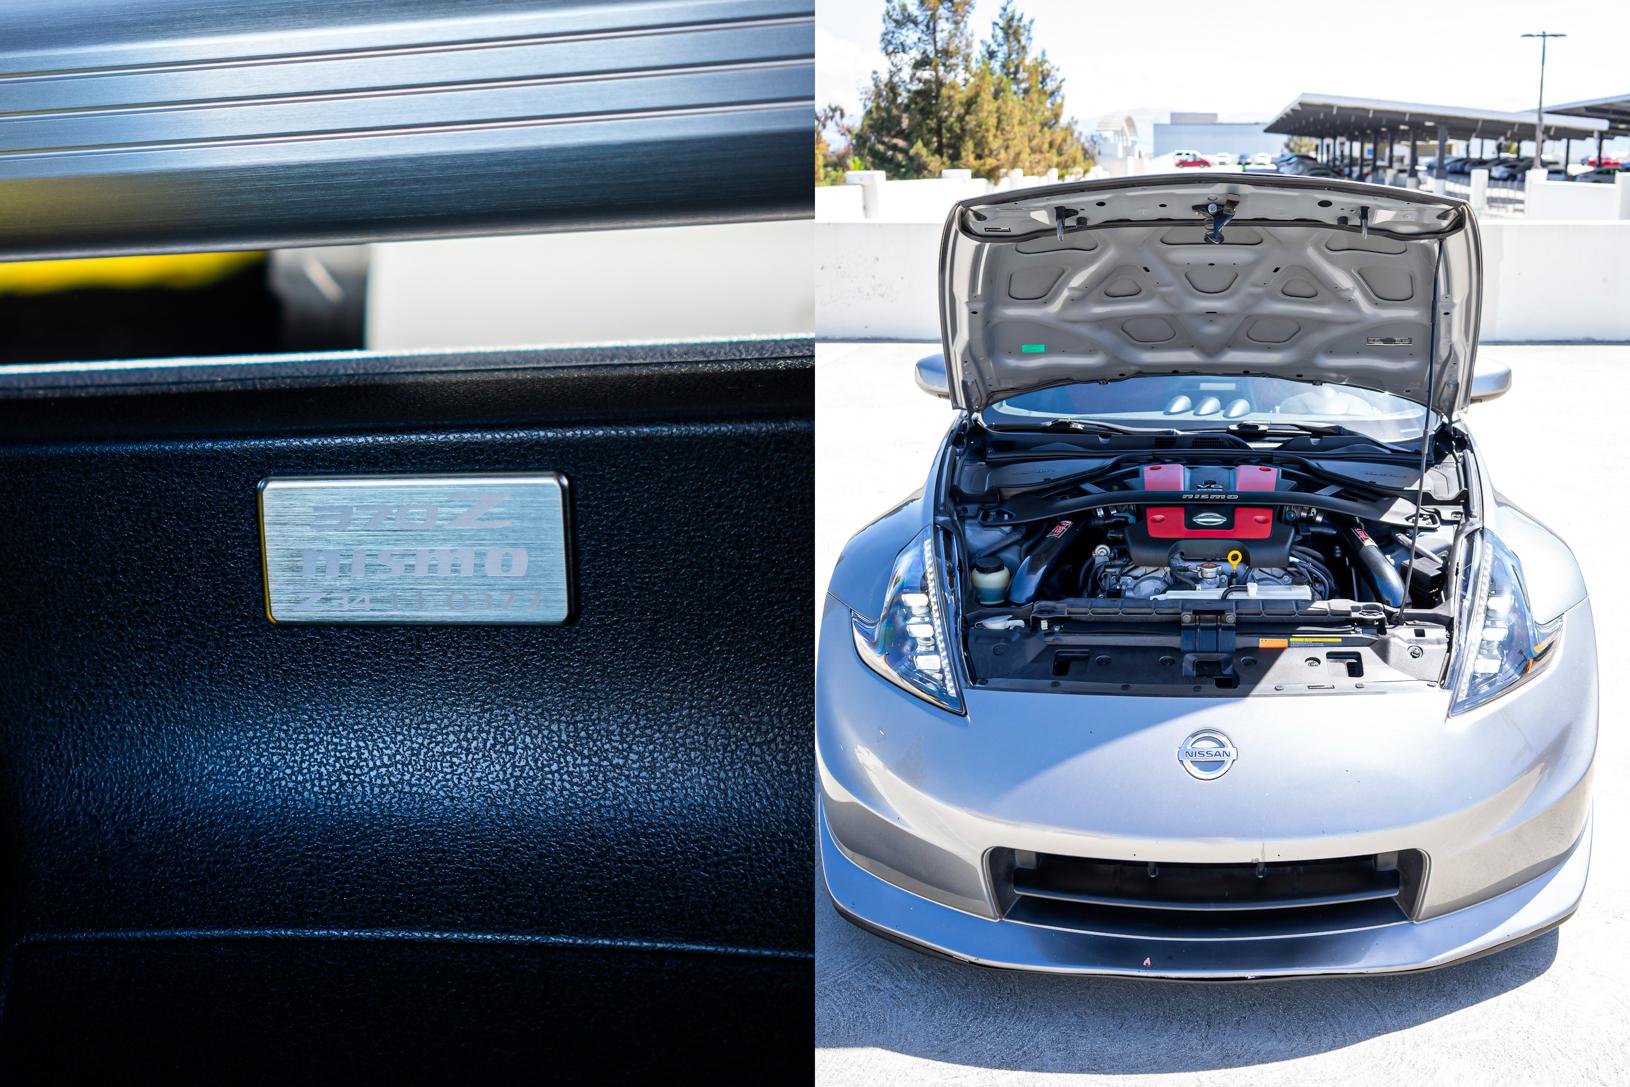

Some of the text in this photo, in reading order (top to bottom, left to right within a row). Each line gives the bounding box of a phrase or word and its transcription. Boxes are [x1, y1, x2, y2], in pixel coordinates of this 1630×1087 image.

[310, 491, 513, 531] 370Z
[298, 591, 372, 611] Z34
[1184, 750, 1231, 758] NISSAN
